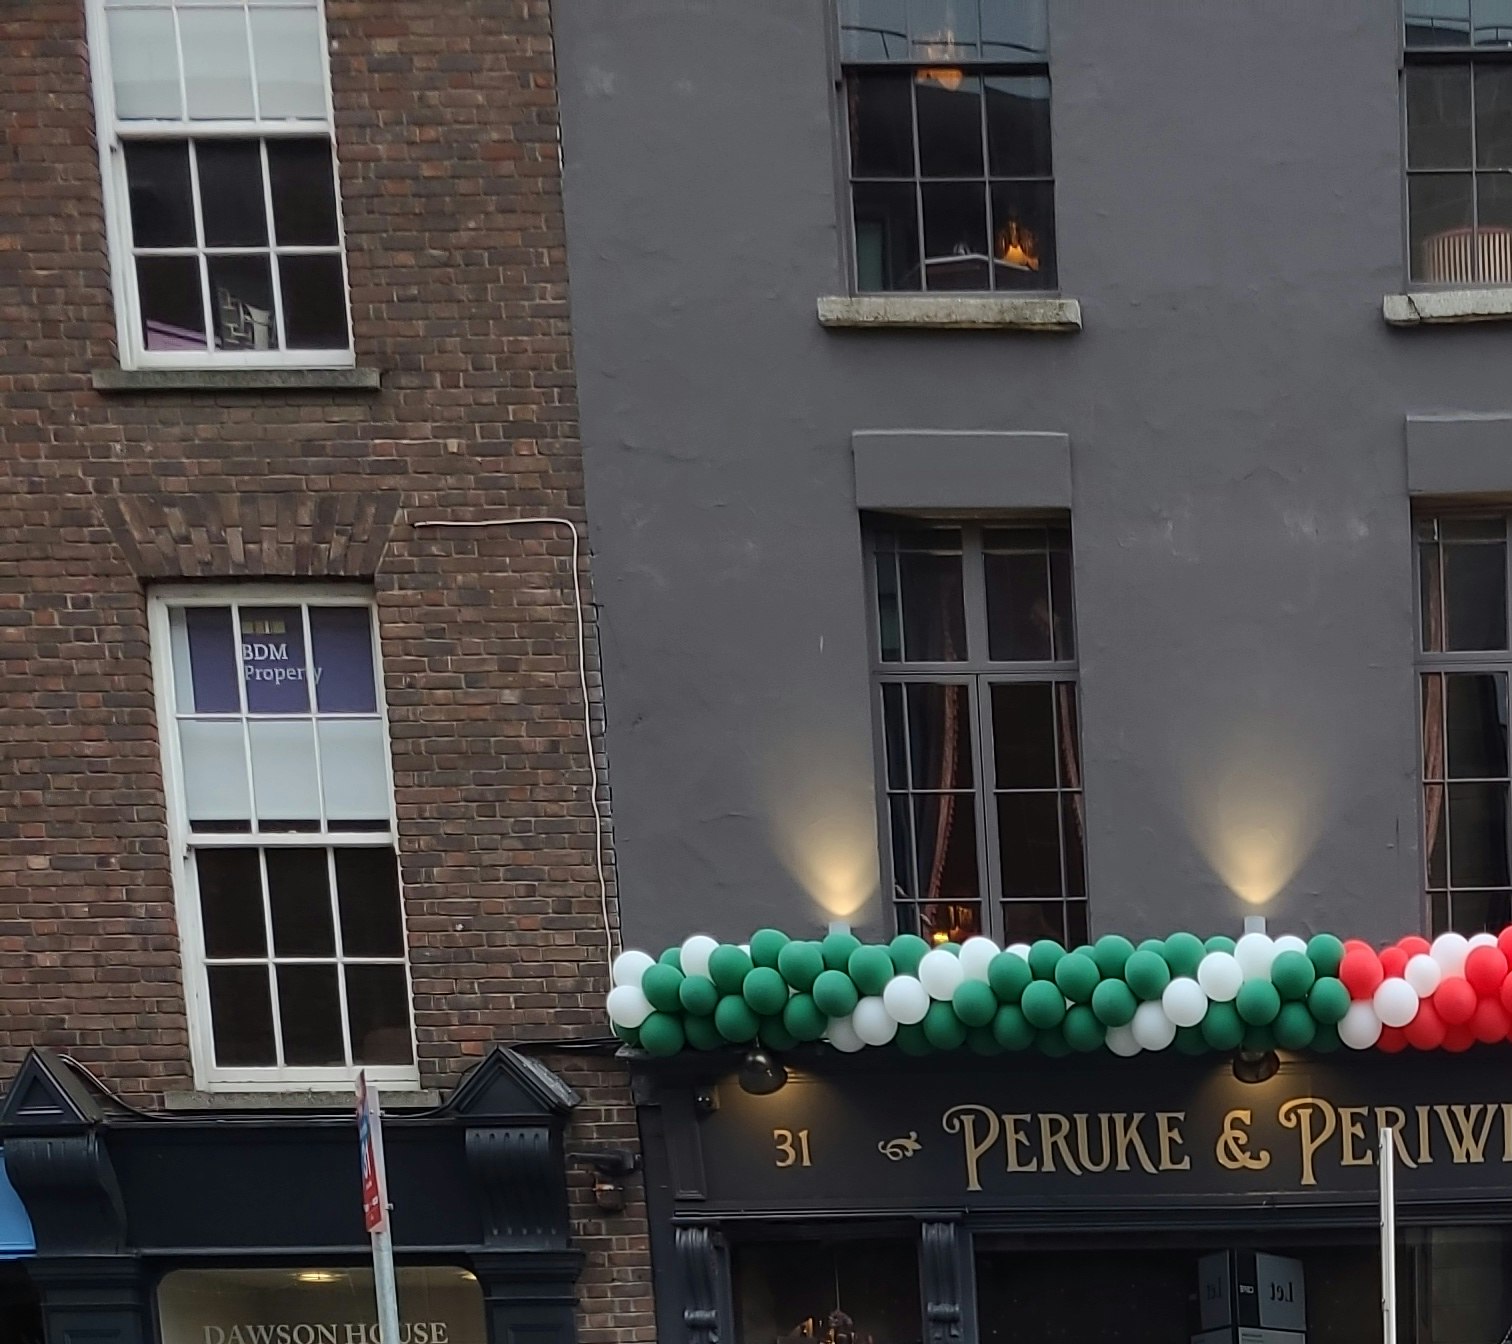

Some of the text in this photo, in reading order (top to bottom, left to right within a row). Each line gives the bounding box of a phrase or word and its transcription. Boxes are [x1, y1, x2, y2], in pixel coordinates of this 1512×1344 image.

[242, 643, 289, 660] BDM
[244, 664, 322, 685] Propery
[773, 1129, 813, 1168] 31
[942, 1104, 1191, 1191] PERUKE
[1215, 1109, 1271, 1170] &
